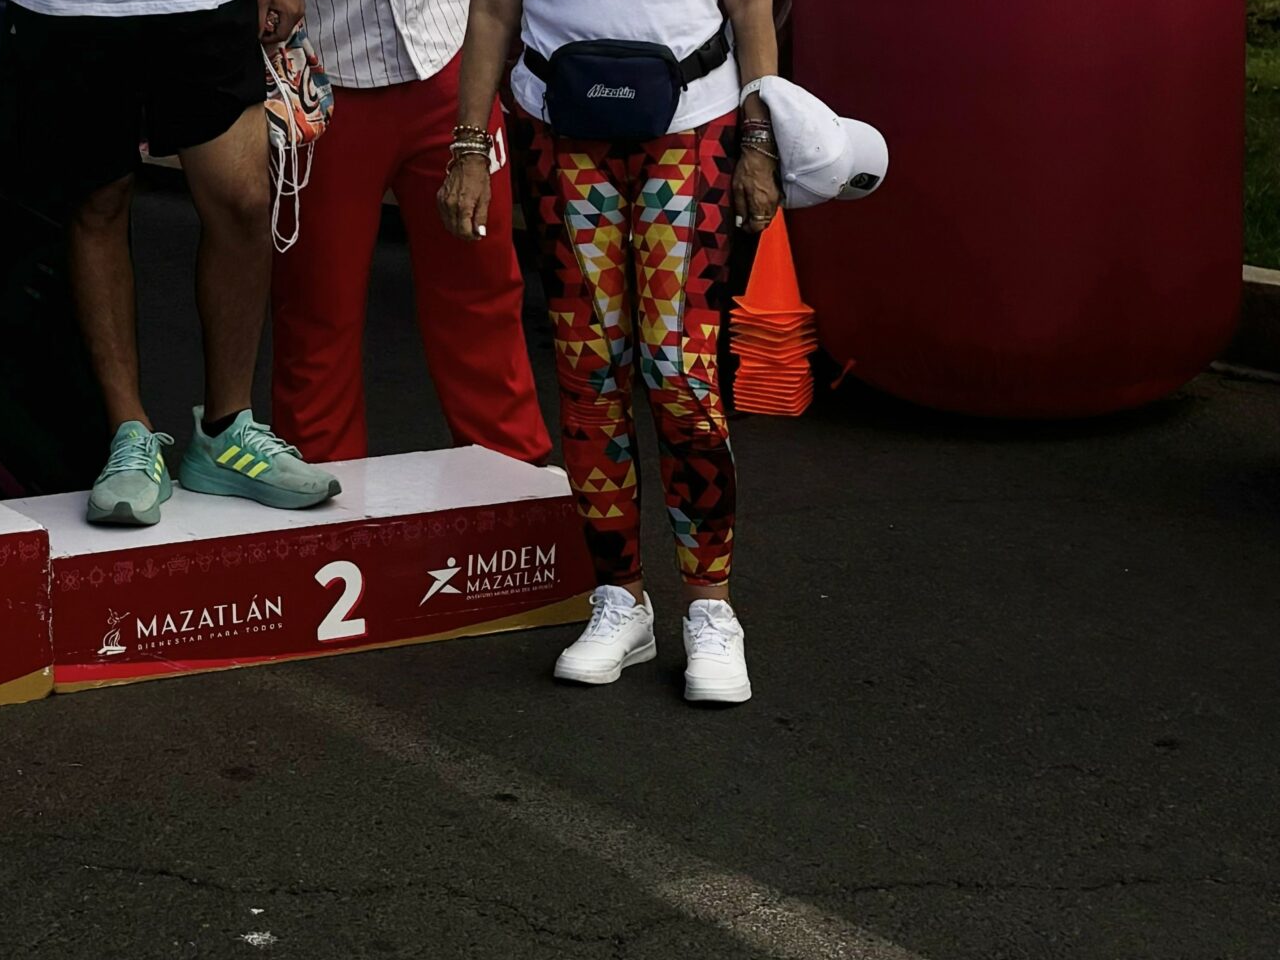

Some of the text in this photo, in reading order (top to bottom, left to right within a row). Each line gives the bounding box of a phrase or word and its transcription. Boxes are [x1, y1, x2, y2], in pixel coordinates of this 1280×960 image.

[467, 543, 556, 576] IMDEM
[466, 567, 555, 594] MAZATLÁN
[136, 594, 282, 639] MAZATLÁN
[314, 560, 366, 641] 2
